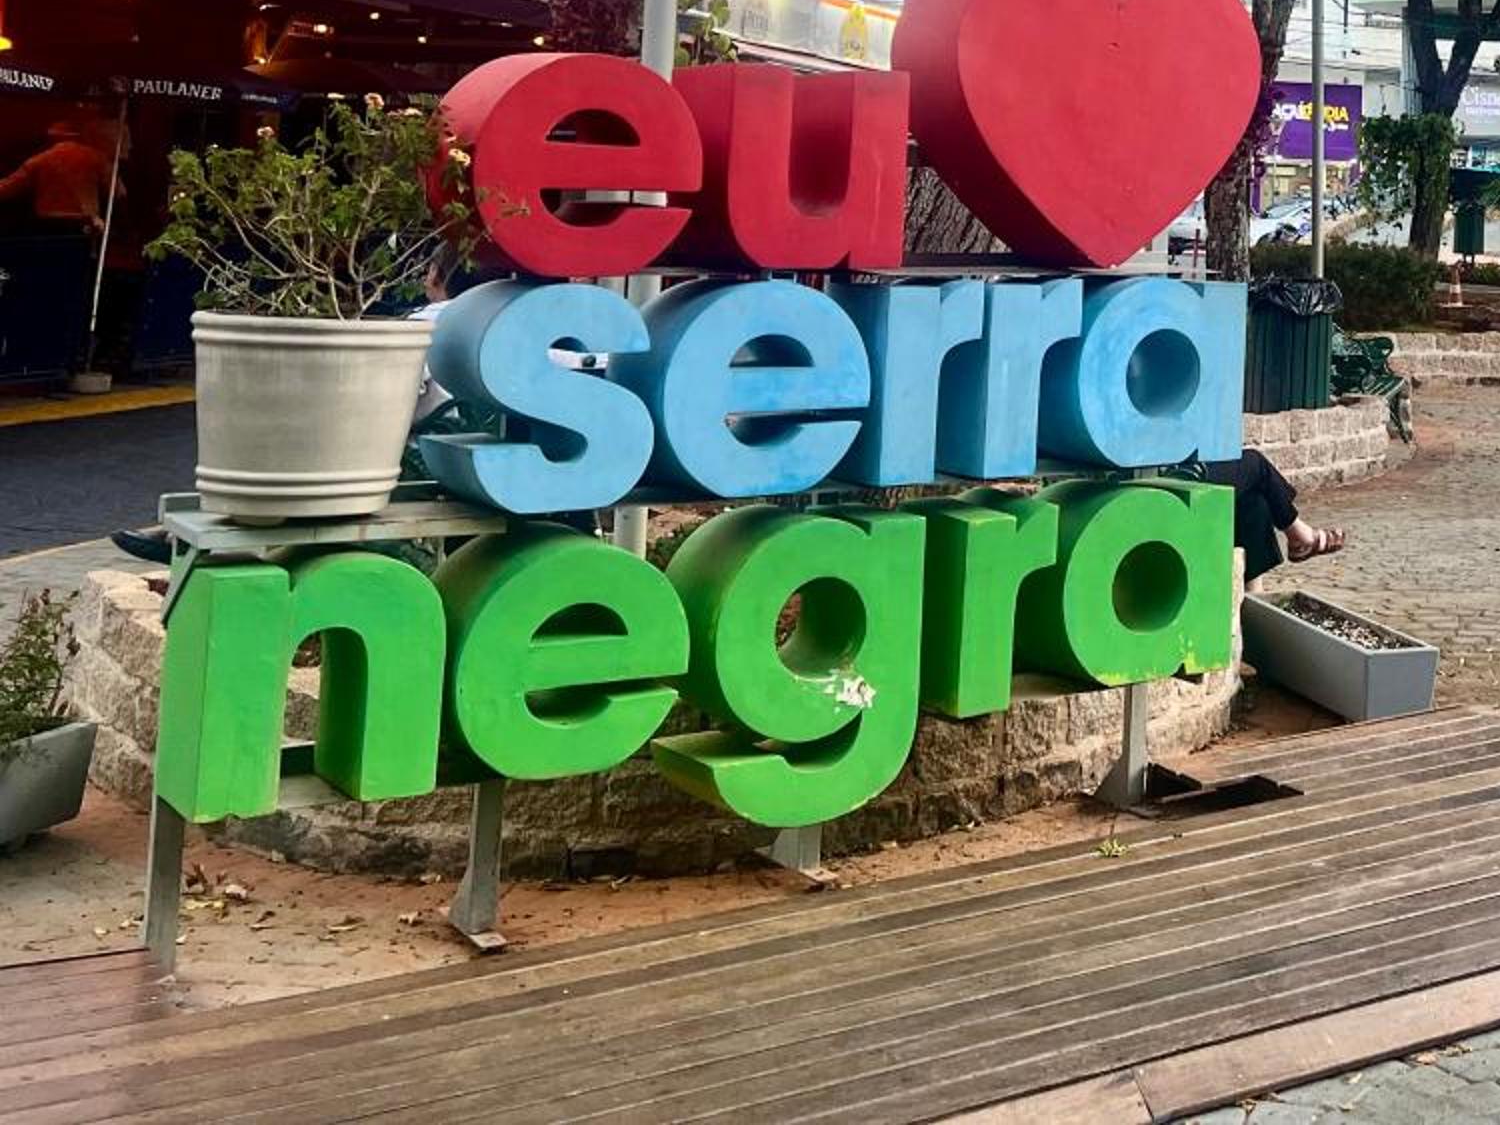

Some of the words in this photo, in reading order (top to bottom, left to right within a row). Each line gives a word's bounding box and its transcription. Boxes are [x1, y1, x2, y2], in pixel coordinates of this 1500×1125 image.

[132, 79, 223, 100] PAULANER
[442, 53, 909, 275] eu
[420, 275, 1247, 515] serra
[157, 478, 1241, 828] negra
